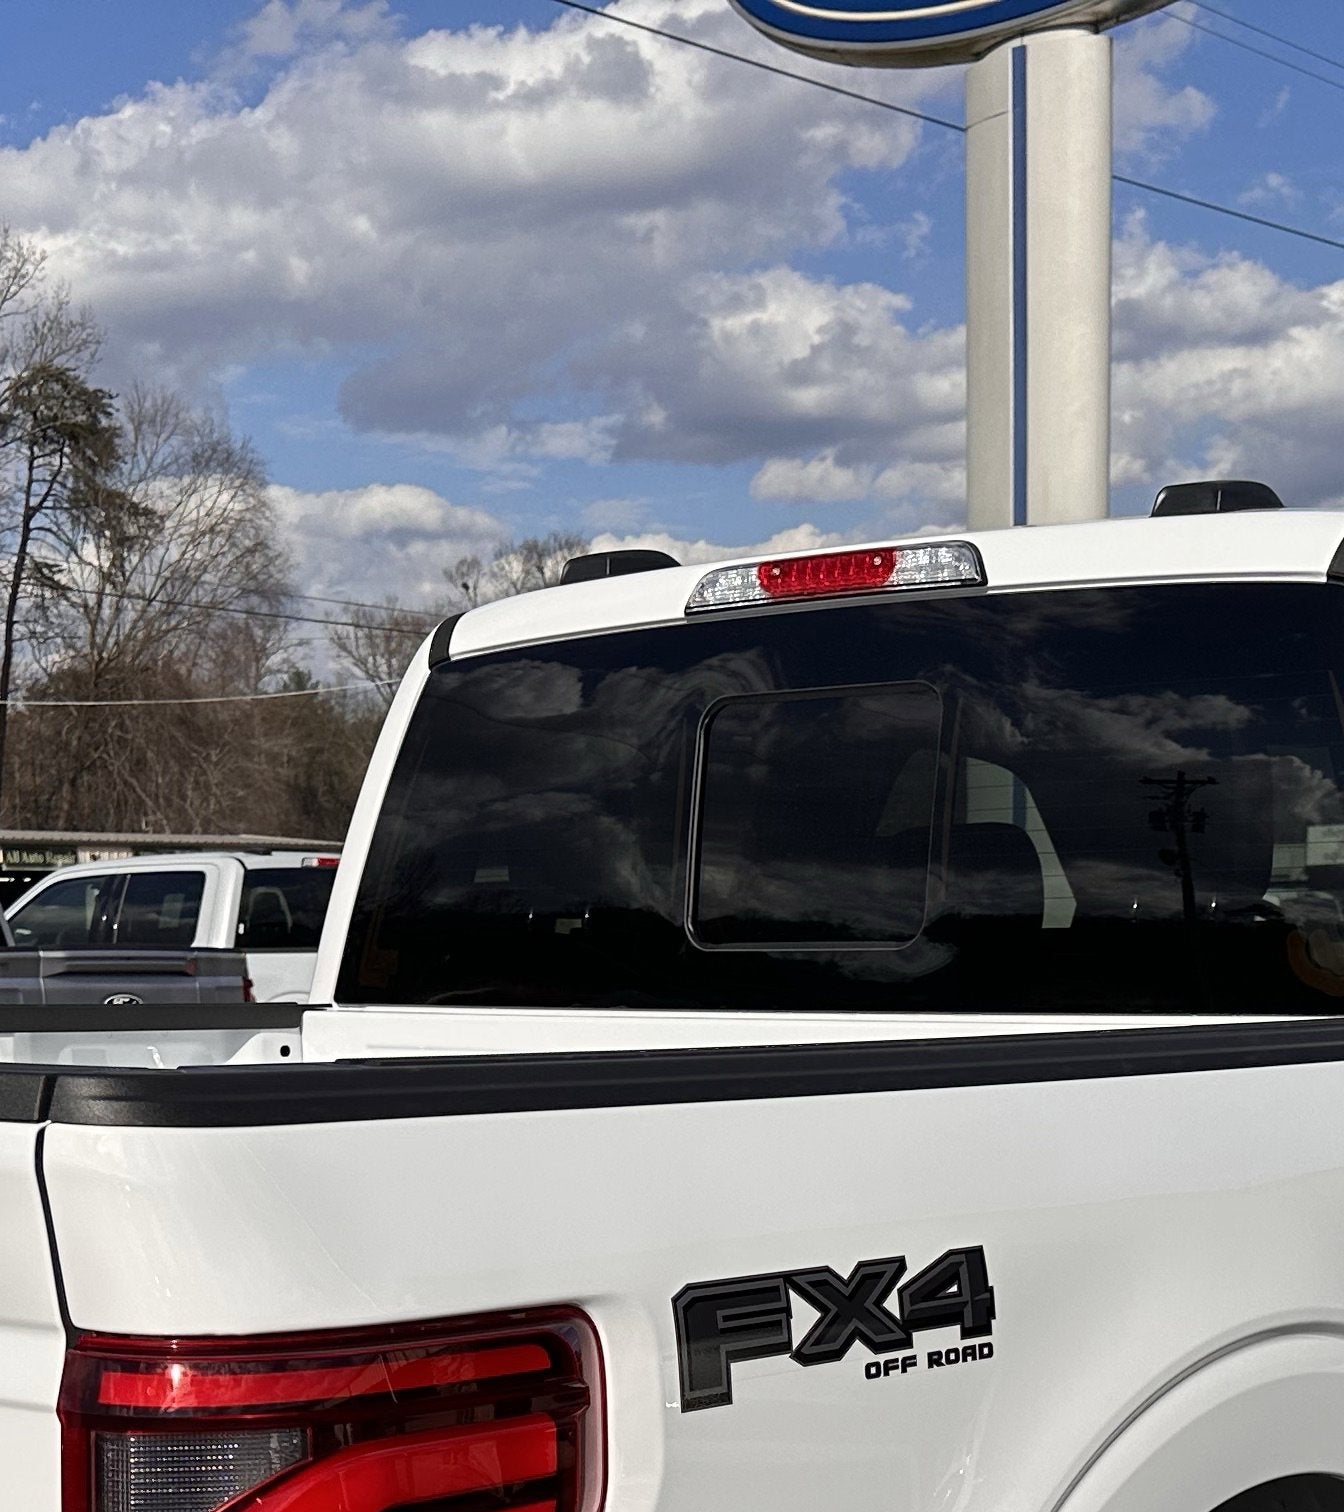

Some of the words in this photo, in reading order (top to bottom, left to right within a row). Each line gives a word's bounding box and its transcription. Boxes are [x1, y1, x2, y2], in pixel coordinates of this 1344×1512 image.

[671, 1245, 996, 1413] FX4
[864, 1354, 918, 1380] OFF
[927, 1341, 995, 1370] ROAD
